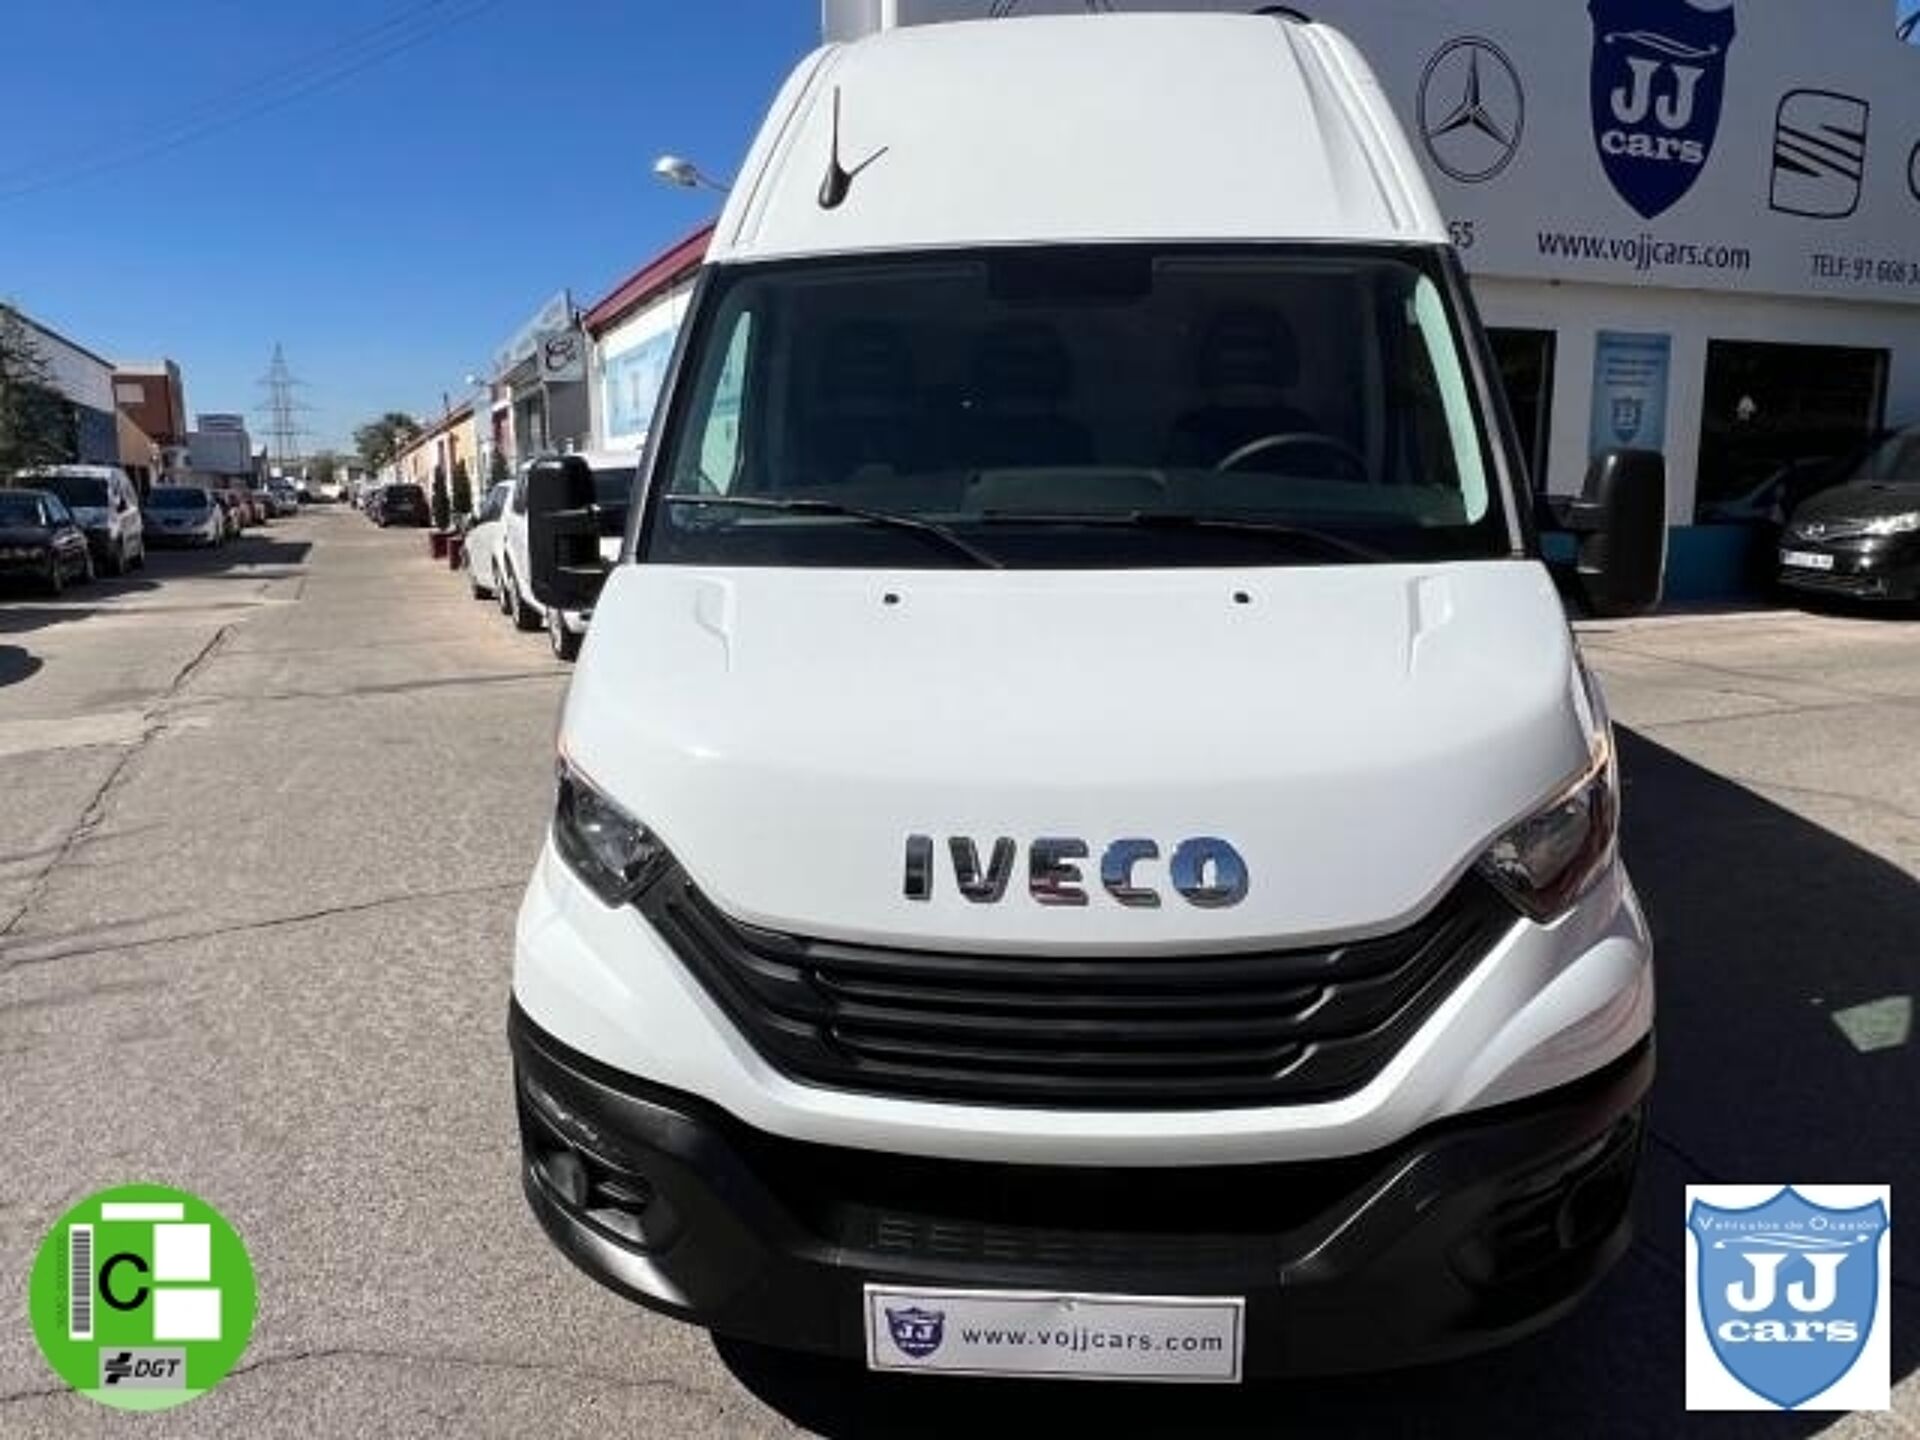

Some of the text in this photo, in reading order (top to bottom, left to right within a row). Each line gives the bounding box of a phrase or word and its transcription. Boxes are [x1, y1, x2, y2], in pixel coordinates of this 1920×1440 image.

[1610, 56, 1705, 130] JJ
[1601, 130, 1704, 164] cars
[1537, 230, 1751, 272] www.vojjcars.com
[903, 833, 1249, 909] IVECO
[962, 1326, 1223, 1352] www.vojjcars.com
